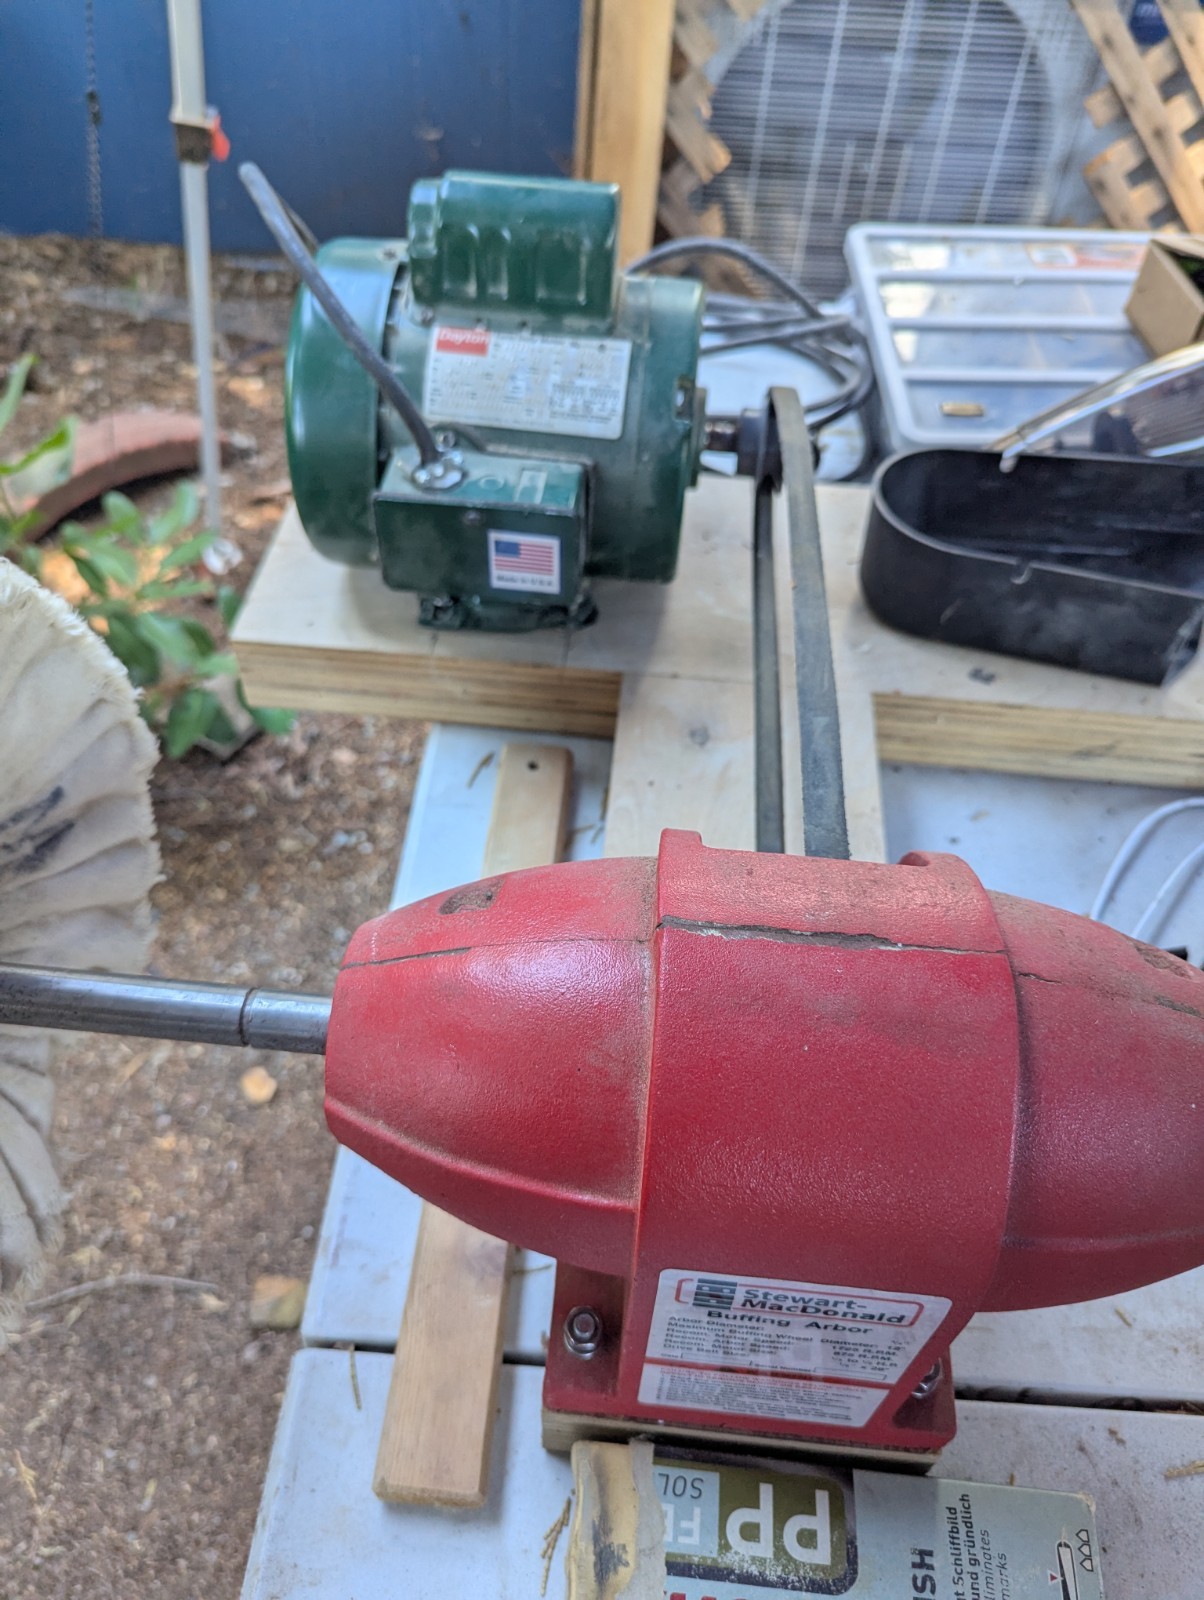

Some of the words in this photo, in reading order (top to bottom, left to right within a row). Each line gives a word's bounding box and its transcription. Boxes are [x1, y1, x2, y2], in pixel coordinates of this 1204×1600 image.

[744, 1289, 867, 1310] Stewart-
[707, 1310, 791, 1328] Buffing
[804, 1321, 874, 1334] Arbor
[741, 1299, 906, 1324] MacDonald
[667, 1321, 725, 1332] Maximum
[729, 1328, 772, 1339] Buffing
[776, 1333, 813, 1342] Wheel
[669, 1316, 703, 1324] Arbor
[707, 1320, 764, 1331] Diameter:
[663, 1343, 693, 1351] Drive
[713, 1338, 746, 1347] Arbor
[715, 1332, 748, 1341] Motor
[711, 1343, 744, 1353] Motor
[655, 1472, 704, 1499] SOL
[725, 1482, 832, 1565] PP
[959, 1493, 981, 1567] gründlich
[945, 1506, 965, 1587] Schliffbild
